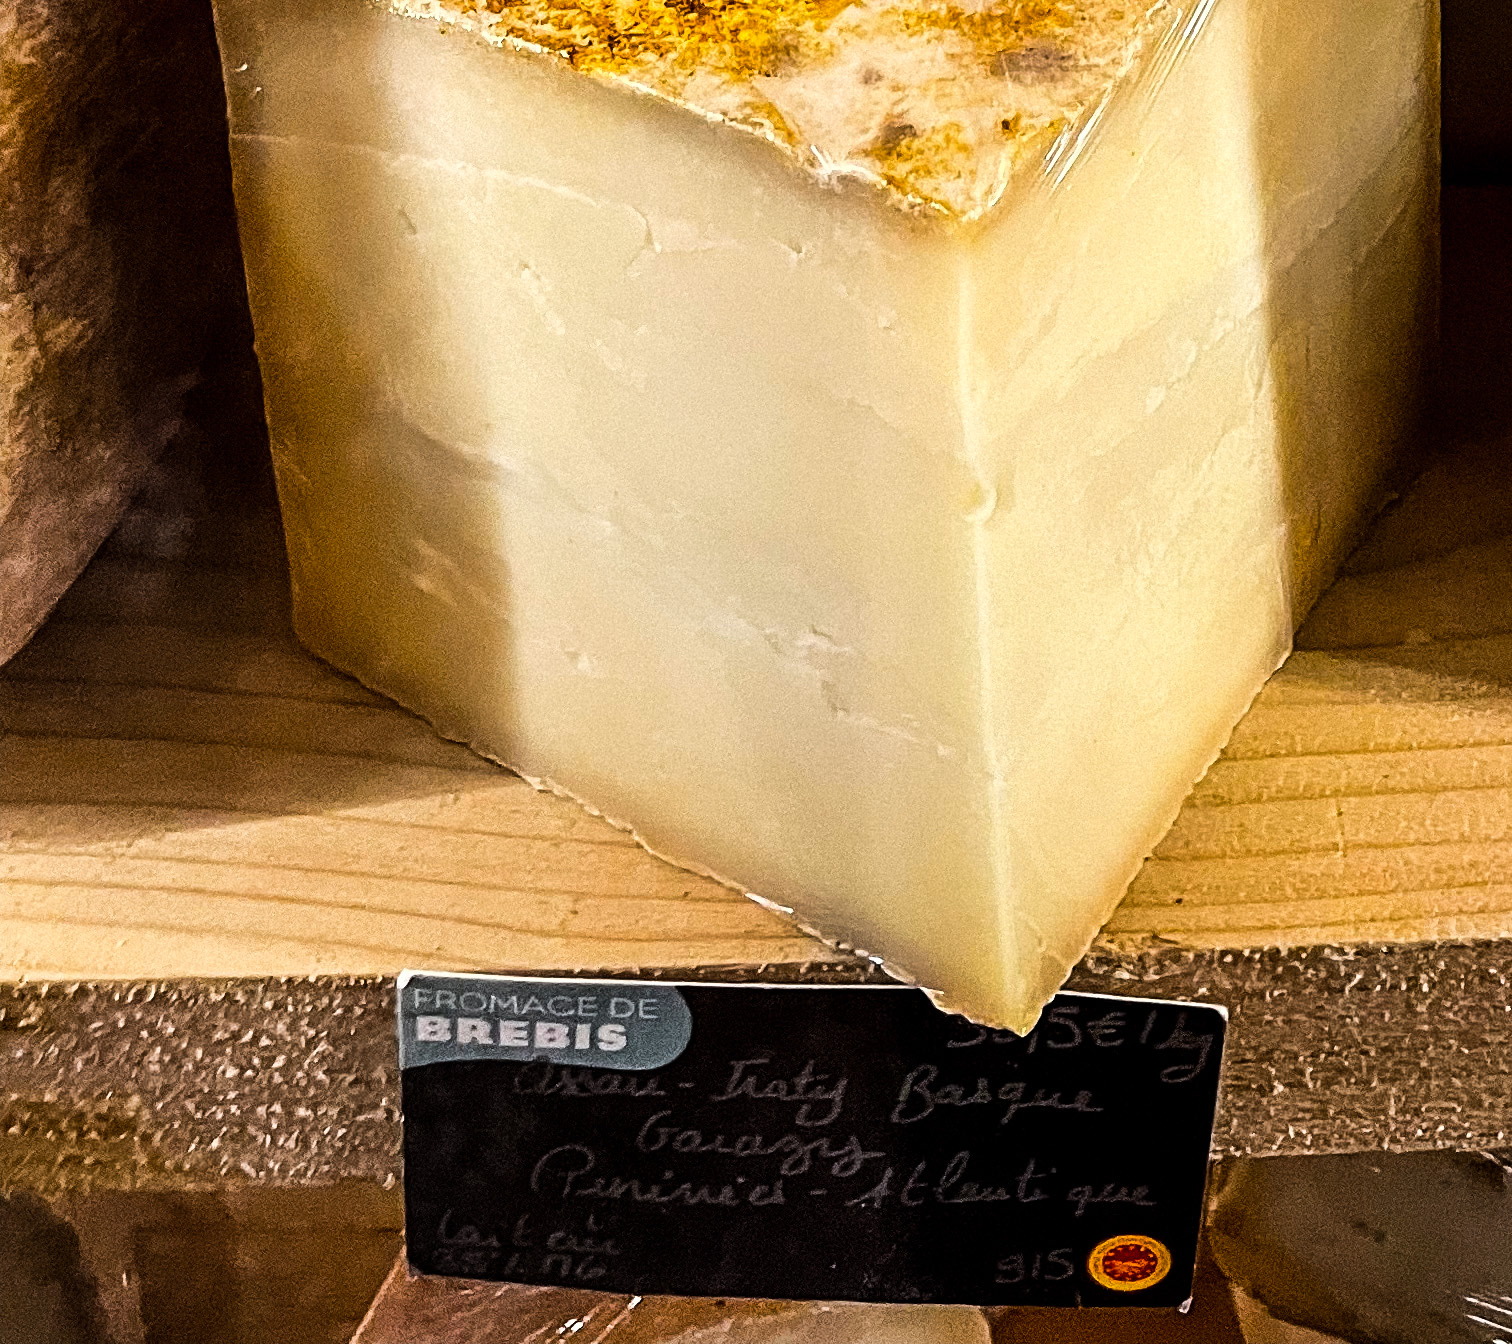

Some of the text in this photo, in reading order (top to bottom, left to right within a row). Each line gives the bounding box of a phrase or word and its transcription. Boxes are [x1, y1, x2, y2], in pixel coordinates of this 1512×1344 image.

[412, 988, 660, 1020] FROMAGE DE
[415, 1015, 628, 1053] BREBIS
